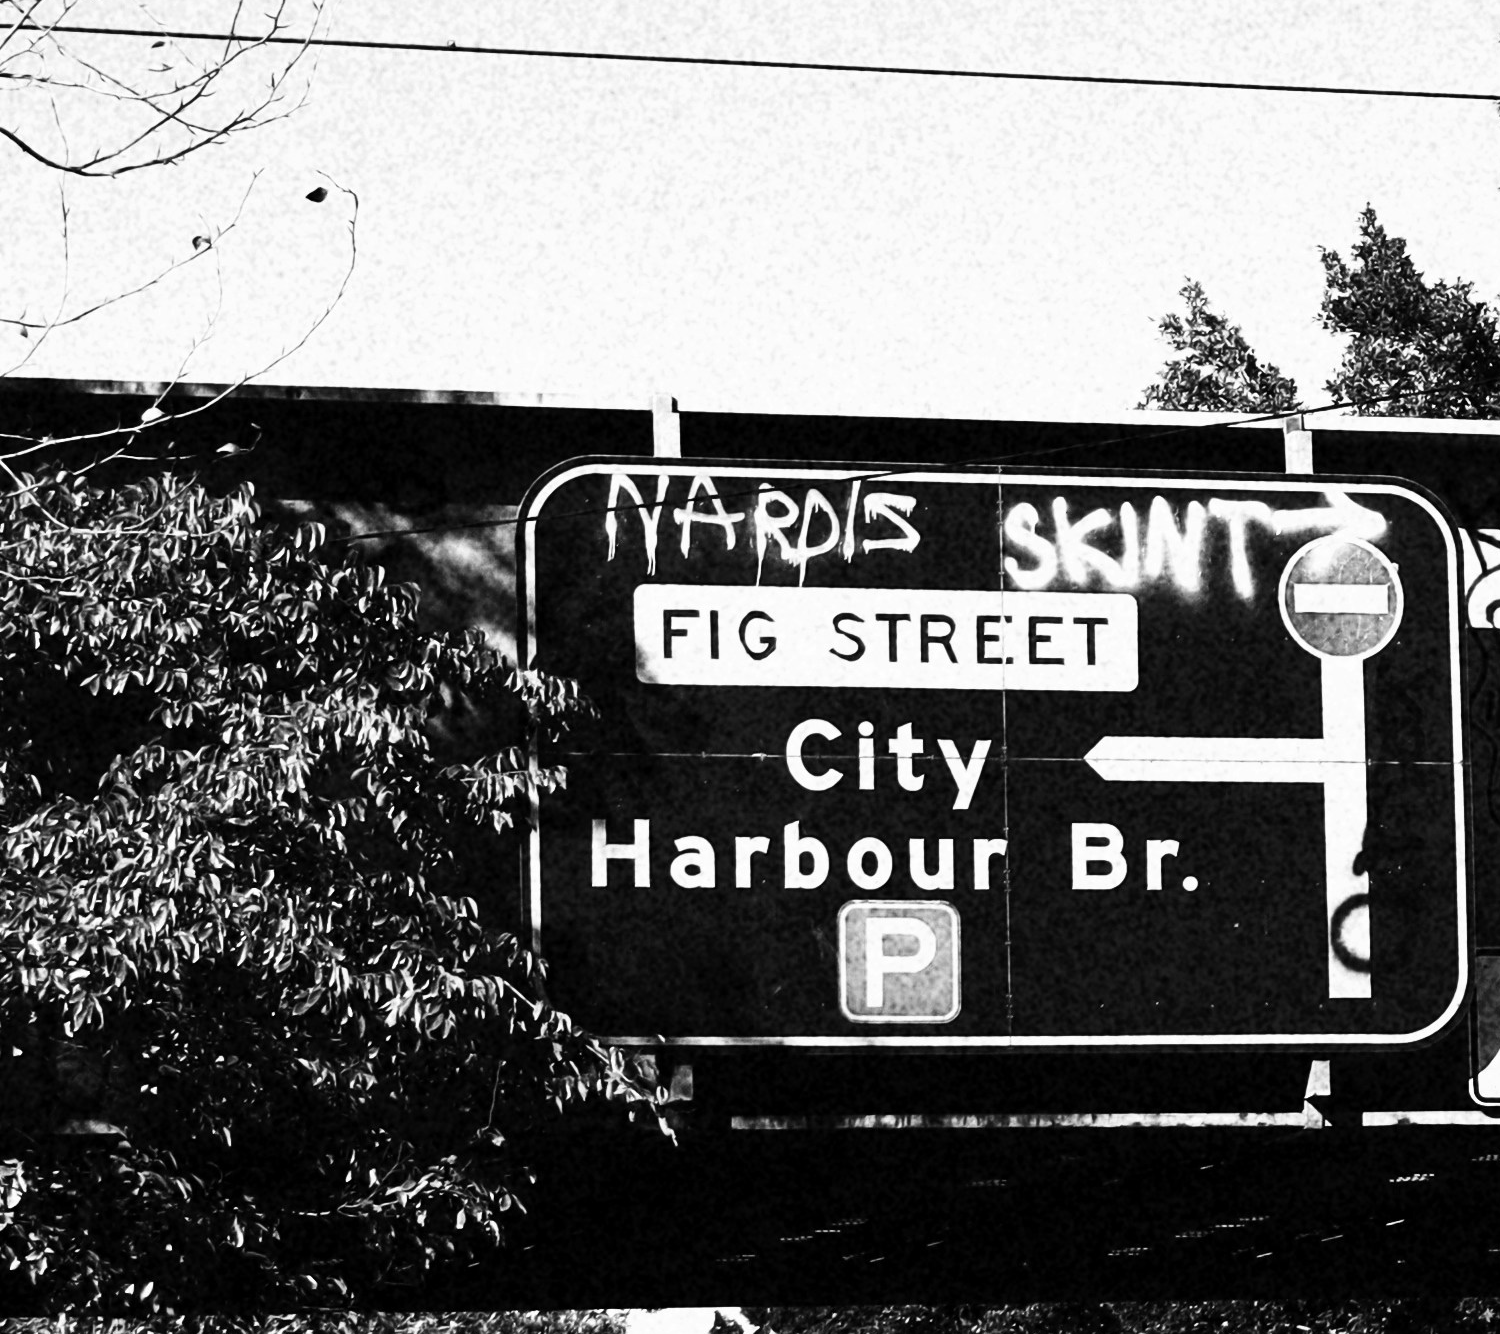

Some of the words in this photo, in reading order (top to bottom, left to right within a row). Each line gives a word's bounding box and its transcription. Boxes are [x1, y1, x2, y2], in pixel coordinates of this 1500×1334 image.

[1003, 495, 1272, 601] SKINT
[661, 609, 779, 659] FIG
[829, 613, 1110, 667] STREET
[785, 718, 993, 811] City
[590, 818, 1009, 892] Harbour
[1070, 821, 1200, 892] Br.
[865, 917, 936, 1008] P
